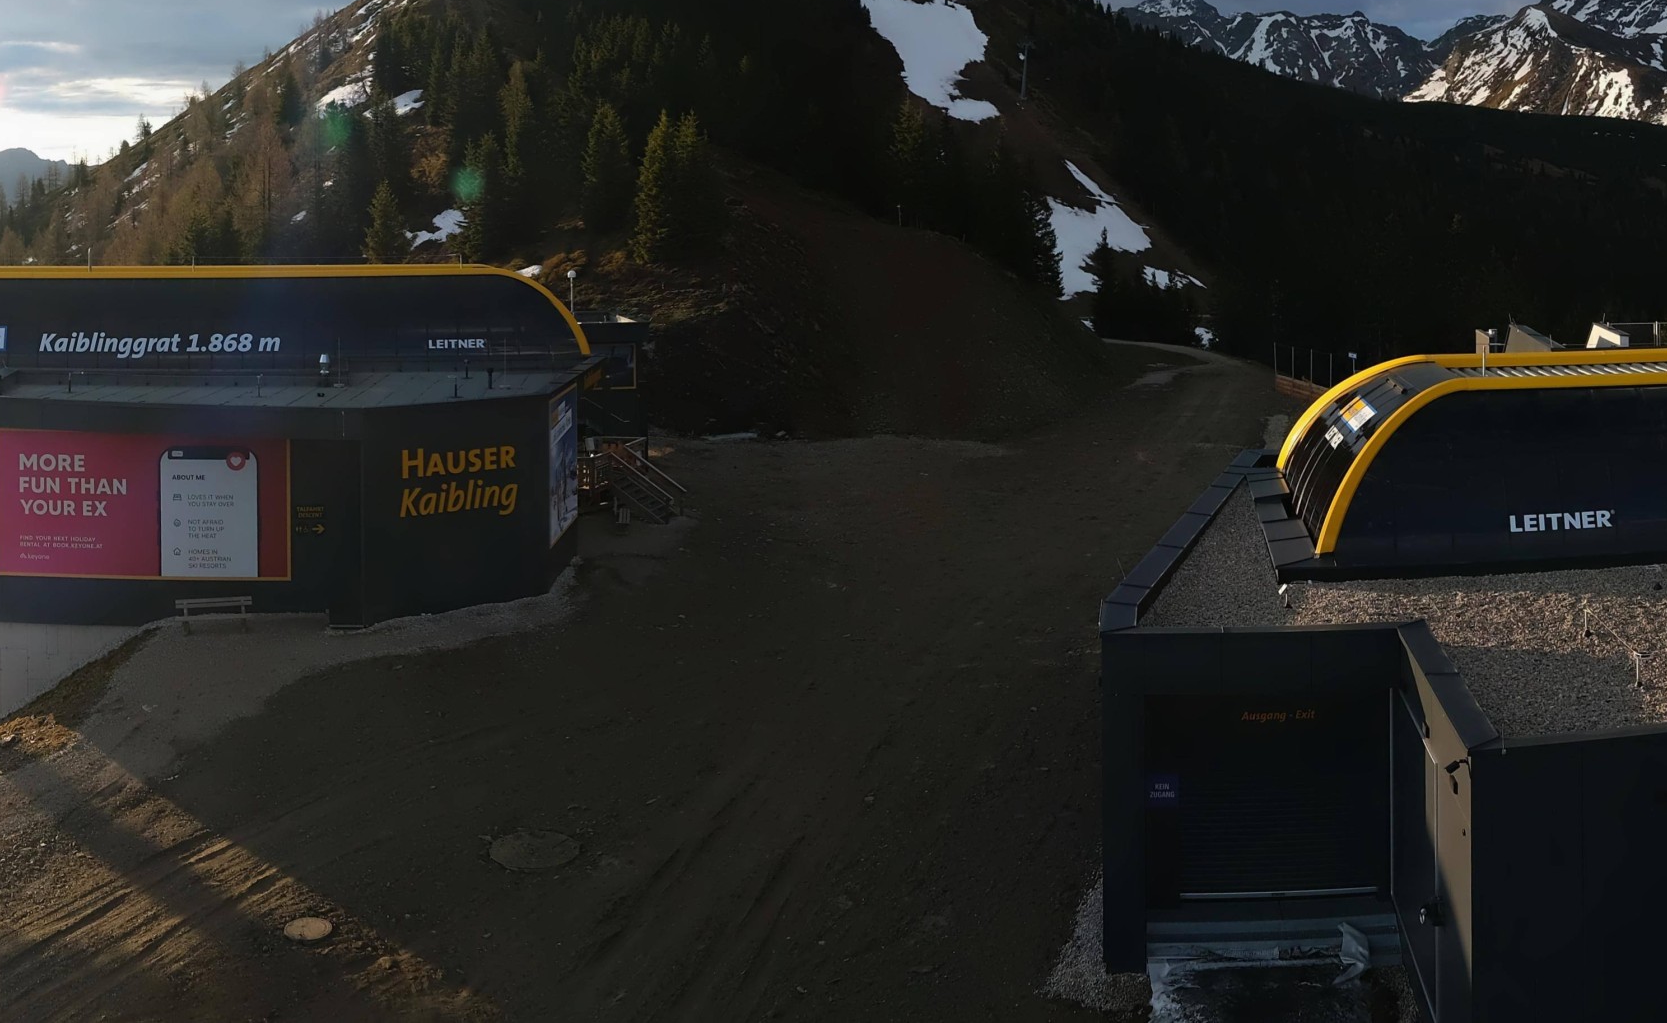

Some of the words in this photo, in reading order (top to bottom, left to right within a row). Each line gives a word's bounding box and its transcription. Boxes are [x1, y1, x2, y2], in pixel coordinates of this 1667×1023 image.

[39, 332, 181, 359] Kaiblinggrat
[186, 333, 253, 352] 1.868
[258, 336, 280, 352] m
[428, 339, 485, 349] LEITNER
[19, 454, 85, 472] MORE
[402, 446, 516, 479] HAUSER
[19, 477, 60, 493] FUN
[68, 478, 127, 495] THAN
[20, 499, 75, 516] YOUR
[82, 500, 107, 516] EX
[400, 479, 518, 518] Kaibling
[1509, 510, 1612, 532] LEITNER
[1241, 711, 1286, 722] Ausgang
[1295, 709, 1315, 720] Exit
